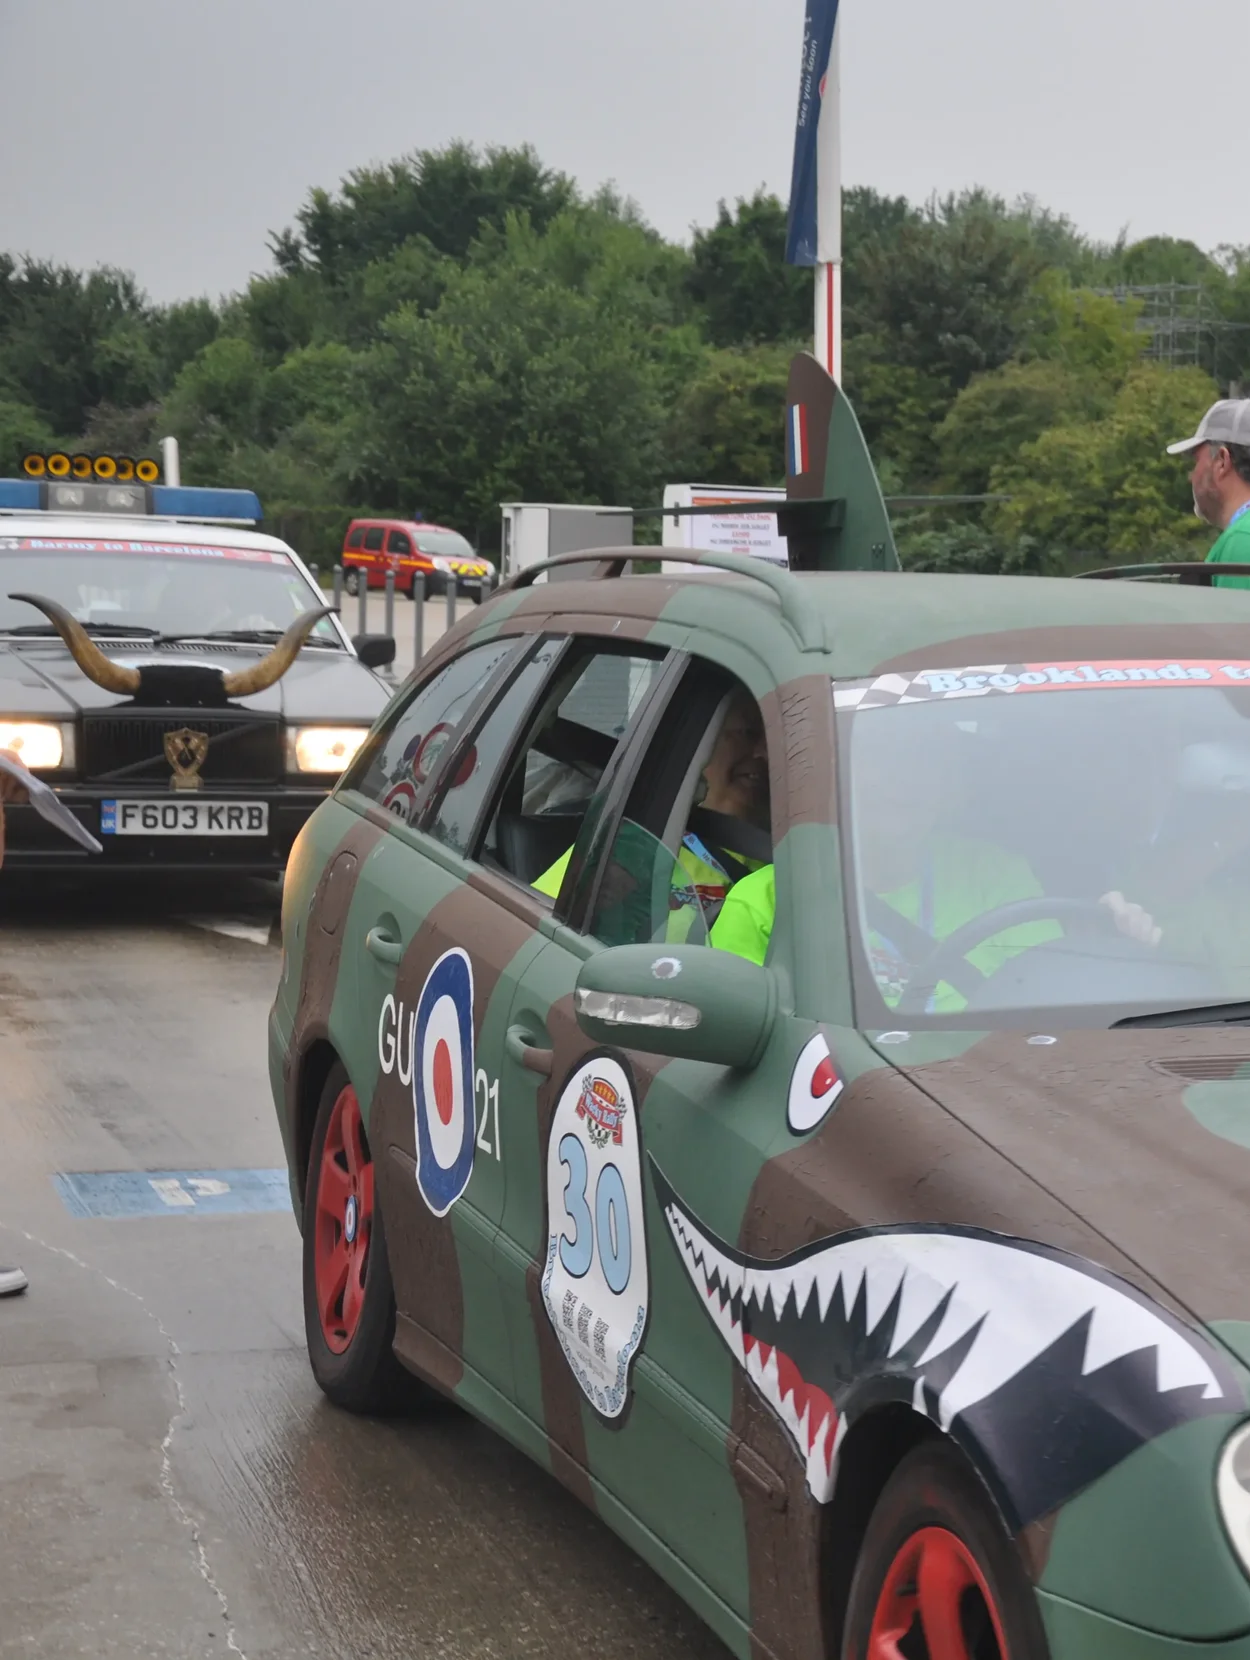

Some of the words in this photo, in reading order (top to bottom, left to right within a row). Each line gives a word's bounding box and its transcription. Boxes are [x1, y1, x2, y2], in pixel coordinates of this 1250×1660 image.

[923, 664, 1212, 693] Brooklands
[101, 819, 115, 828] UK
[121, 804, 198, 830] F603
[207, 805, 264, 830] KRB
[378, 993, 413, 1087] GU
[475, 1068, 500, 1162] 21
[558, 1132, 632, 1296] 30
